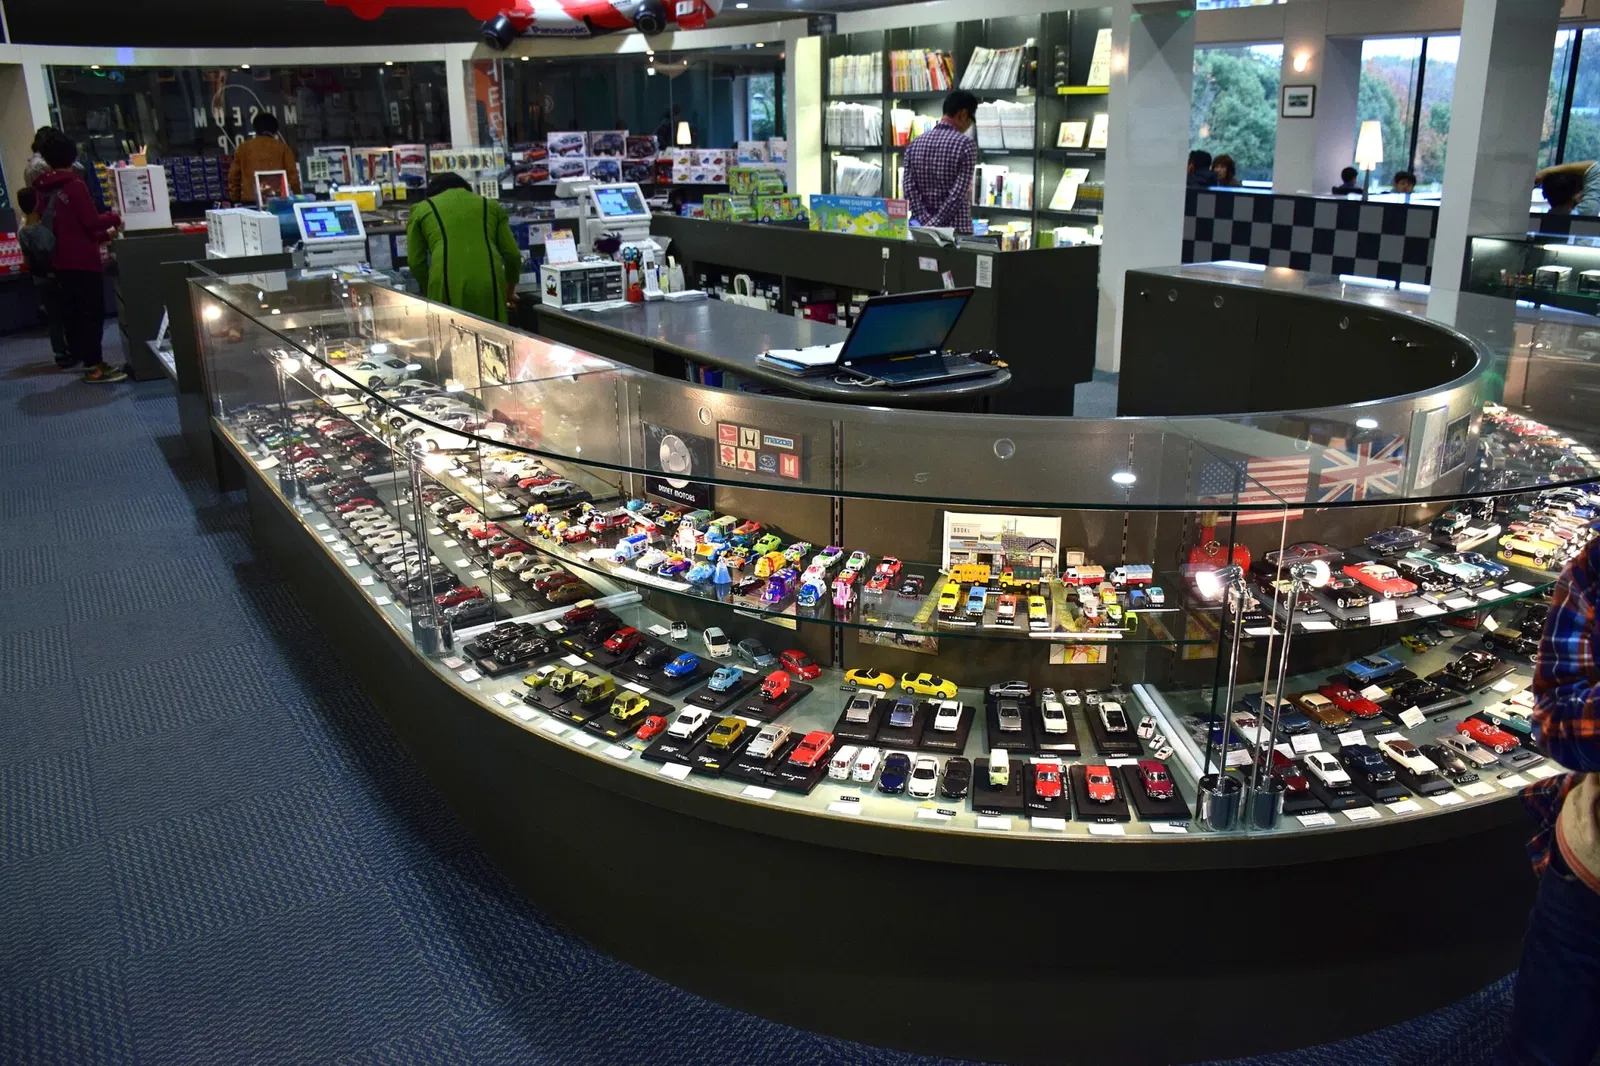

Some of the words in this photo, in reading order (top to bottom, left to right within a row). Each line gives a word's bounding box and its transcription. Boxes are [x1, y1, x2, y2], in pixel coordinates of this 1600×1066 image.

[531, 25, 588, 34] Panasonic
[764, 436, 793, 447] mazda
[658, 484, 673, 495] DISNEY
[674, 490, 696, 502] MOTORS
